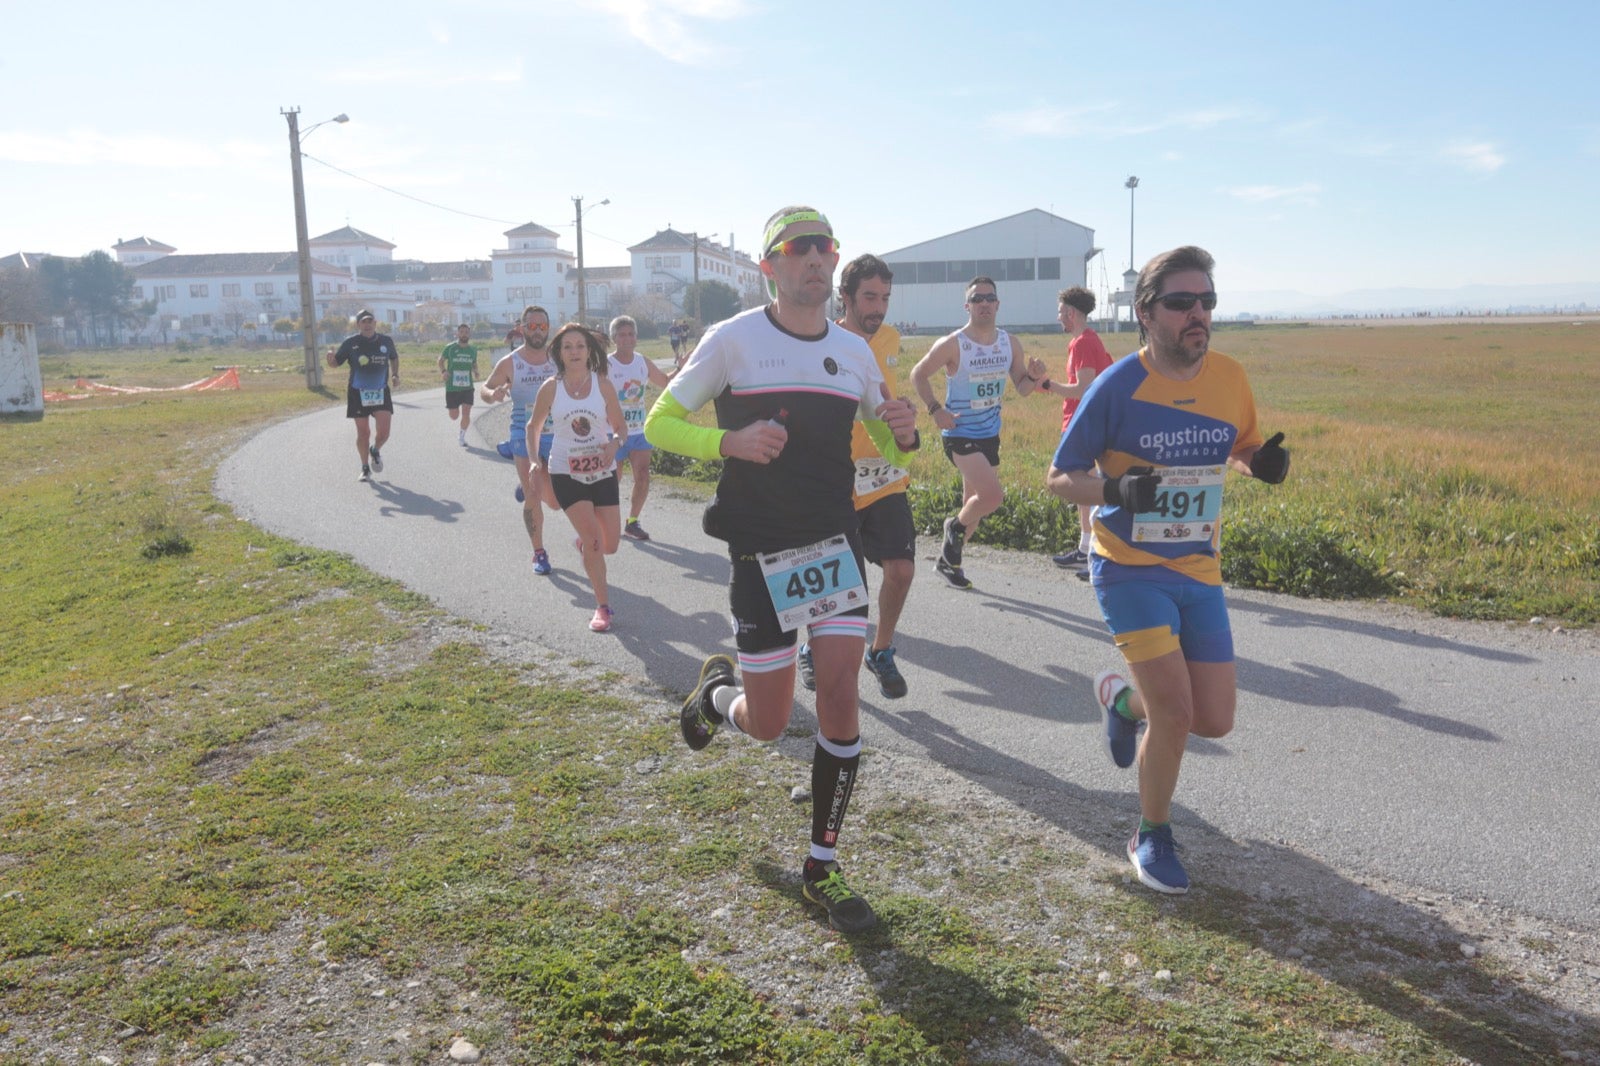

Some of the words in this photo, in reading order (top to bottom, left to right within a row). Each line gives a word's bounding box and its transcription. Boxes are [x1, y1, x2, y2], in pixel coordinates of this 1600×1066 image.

[969, 355, 1008, 368] MARACENA
[976, 381, 1000, 397] 651
[624, 409, 642, 421] 871
[1139, 425, 1230, 453] agustinos
[1155, 447, 1219, 460] GRANADA
[1154, 489, 1207, 519] 491
[786, 558, 841, 599] 497
